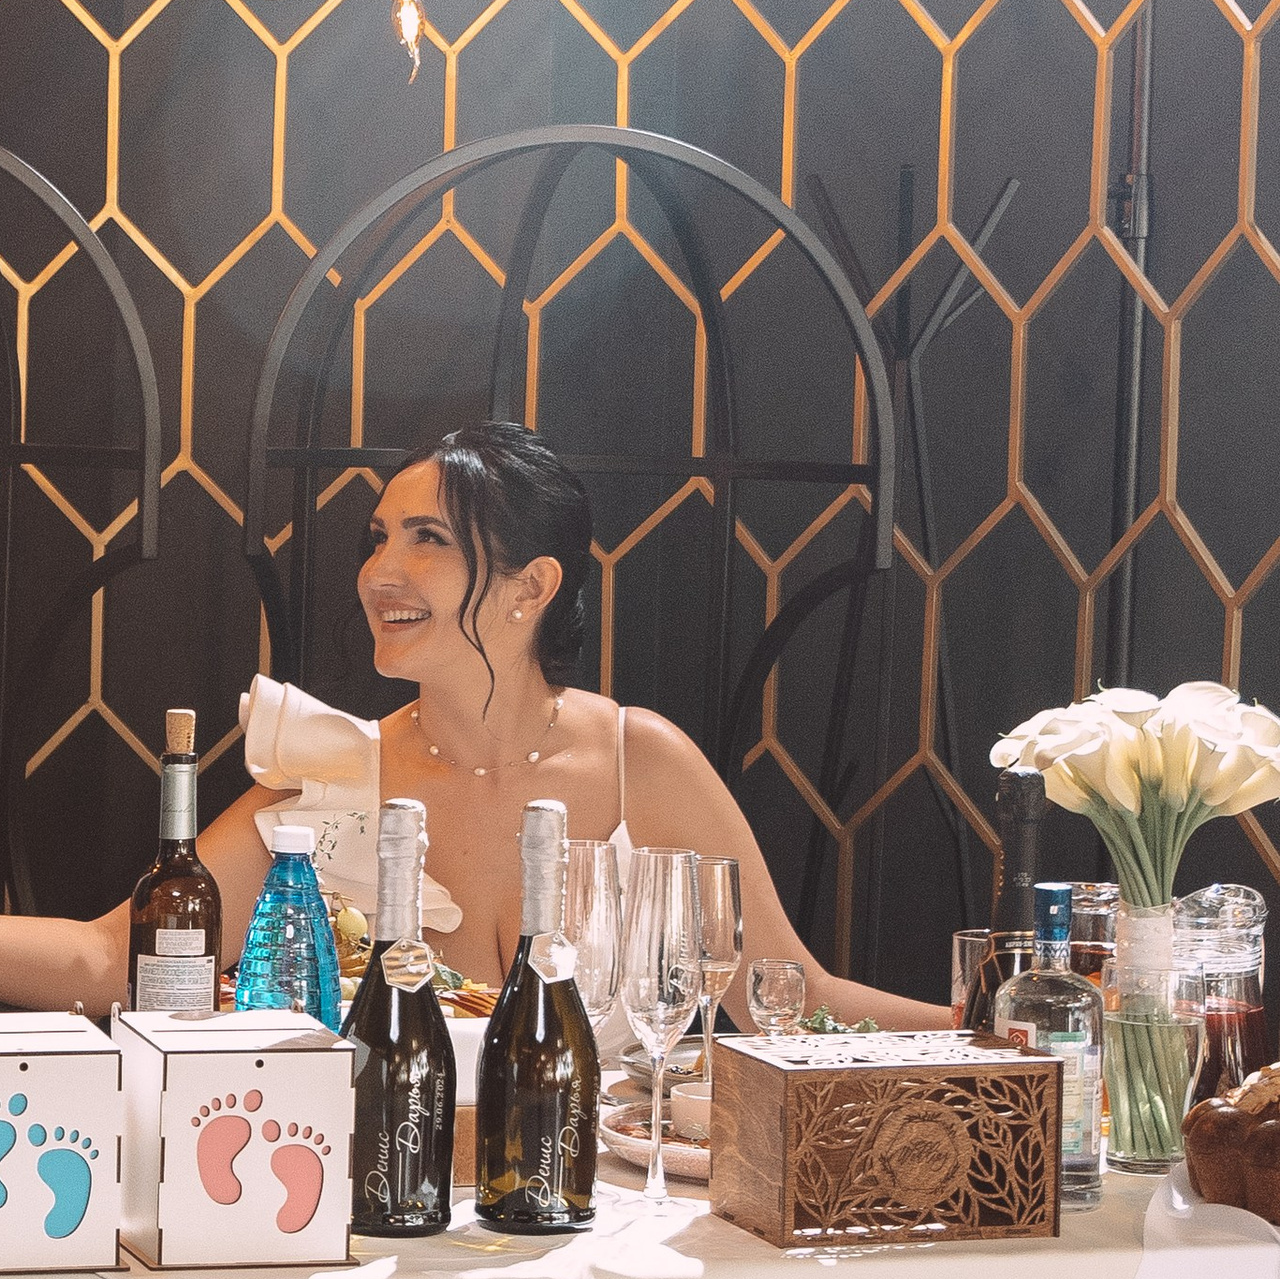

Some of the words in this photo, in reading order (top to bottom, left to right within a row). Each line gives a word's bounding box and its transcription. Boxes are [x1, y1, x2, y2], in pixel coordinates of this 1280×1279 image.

[395, 1068, 430, 1154] Дарья
[557, 1075, 587, 1158] Дарья
[365, 1131, 391, 1203] Денис
[525, 1135, 552, 1208] Денис
